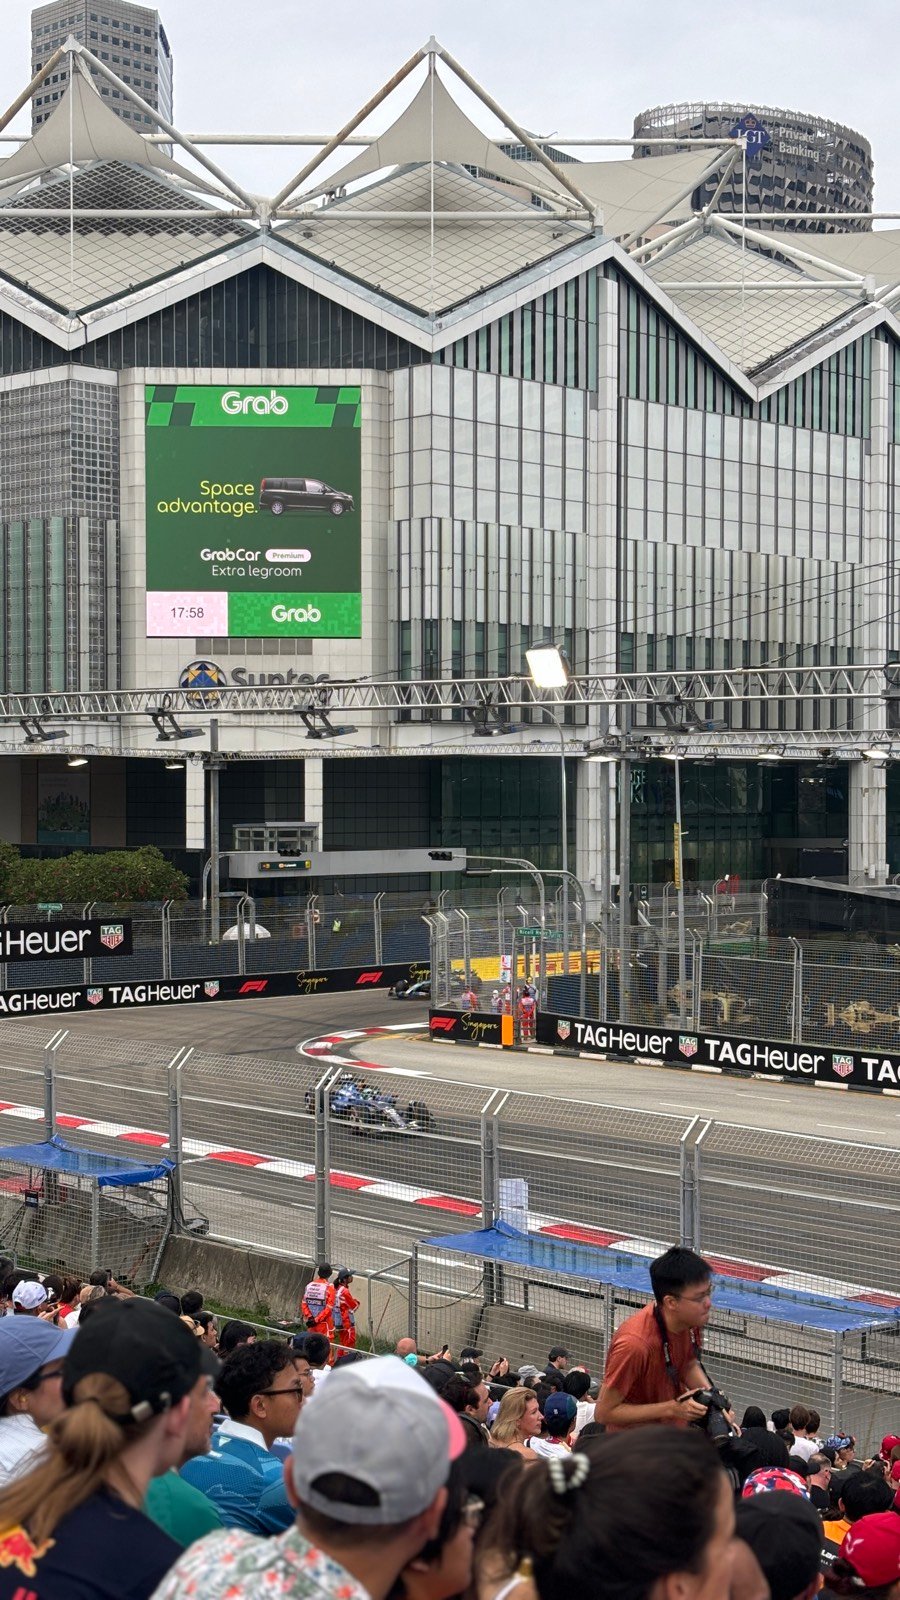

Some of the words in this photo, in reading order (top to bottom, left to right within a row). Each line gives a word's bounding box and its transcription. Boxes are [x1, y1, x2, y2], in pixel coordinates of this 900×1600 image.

[737, 129, 765, 144] LGT
[780, 127, 815, 143] Private
[780, 141, 820, 162] Banking
[221, 390, 288, 415] Grab
[200, 480, 254, 499] Space
[157, 498, 258, 517] advantage.
[200, 548, 261, 562] GrabCar
[272, 552, 305, 560] Premium
[212, 565, 245, 577] Extra
[248, 565, 302, 580] legroom
[171, 607, 204, 618] 17:58
[271, 604, 321, 622] Grab
[103, 926, 122, 935] TAG
[0, 929, 91, 955] Heuer
[101, 935, 123, 948] HEUER
[355, 971, 383, 984] F1
[238, 979, 268, 993] F1
[430, 1016, 457, 1031] F1
[461, 1012, 499, 1040] Singapore
[681, 1036, 696, 1045] TAG
[834, 1055, 852, 1065] TAG
[861, 1057, 900, 1084] TA
